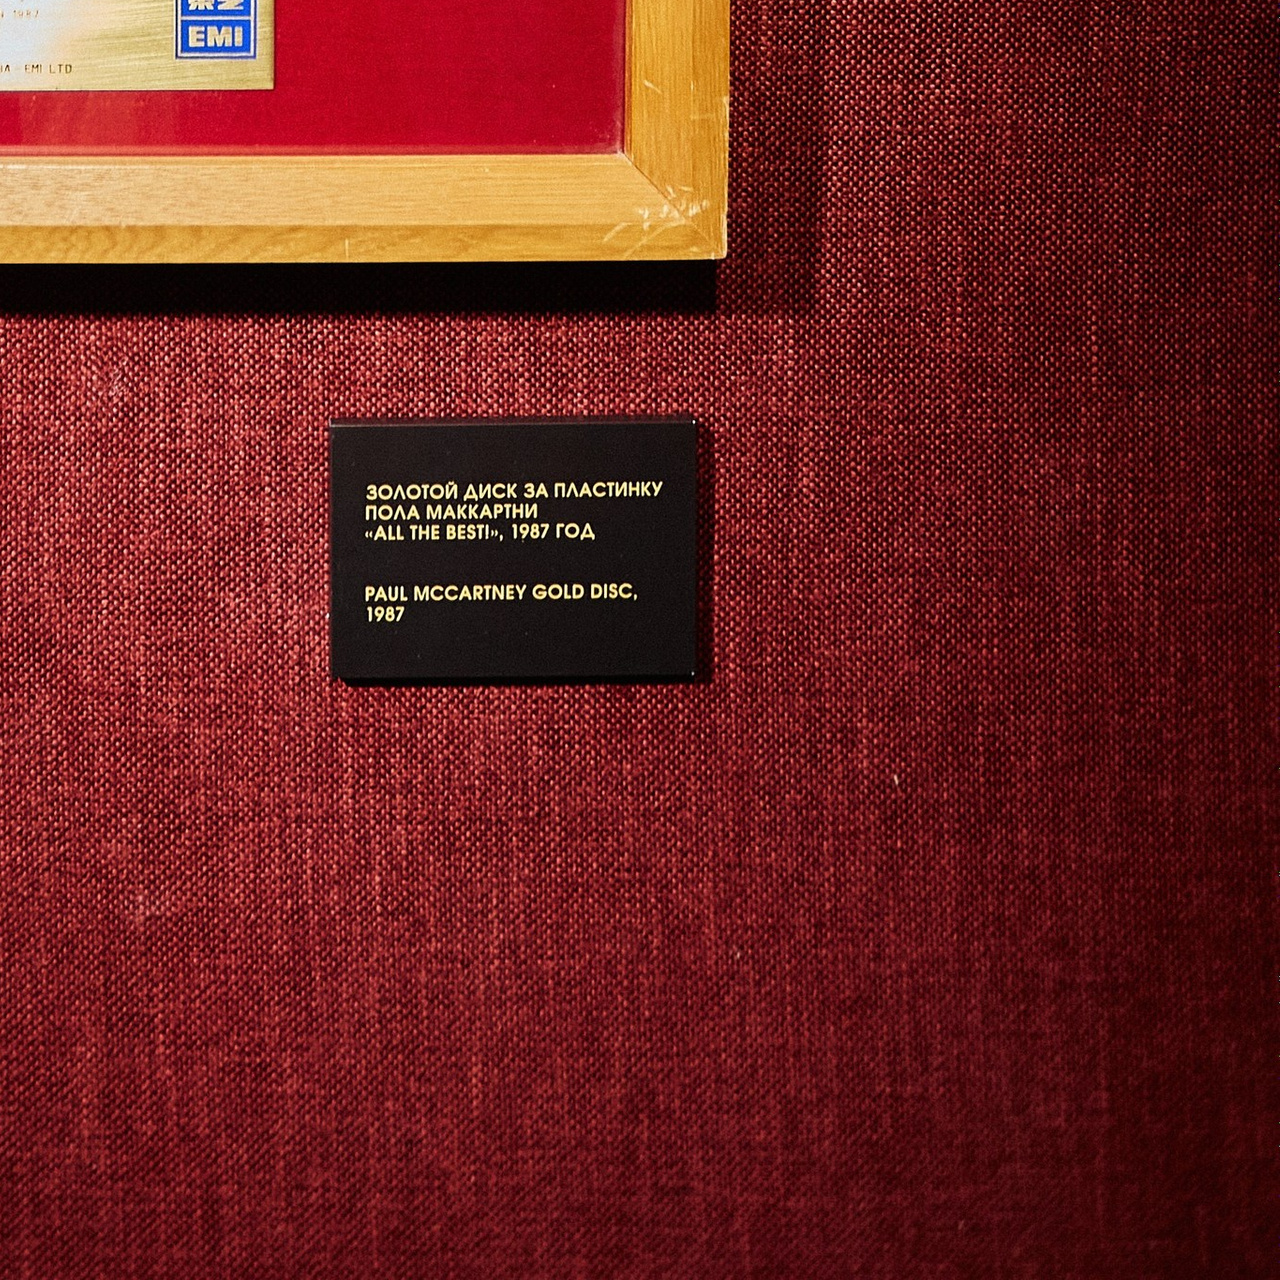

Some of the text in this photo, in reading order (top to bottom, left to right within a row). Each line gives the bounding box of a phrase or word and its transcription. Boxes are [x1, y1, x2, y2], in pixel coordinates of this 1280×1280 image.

[186, 25, 244, 48] EMI
[49, 63, 73, 74] LTD
[365, 481, 664, 502] ЗОЛОТОЙ ДИСК ЗА ПЛАСТИНКУ
[365, 504, 538, 521] ПОЛА МАККАРТНИ
[364, 523, 596, 542] «ALL THE BEST!», 1987 ГОД
[365, 584, 639, 602] PAUL MCCARTNEY GOLD DISC,
[365, 606, 405, 623] 1987
